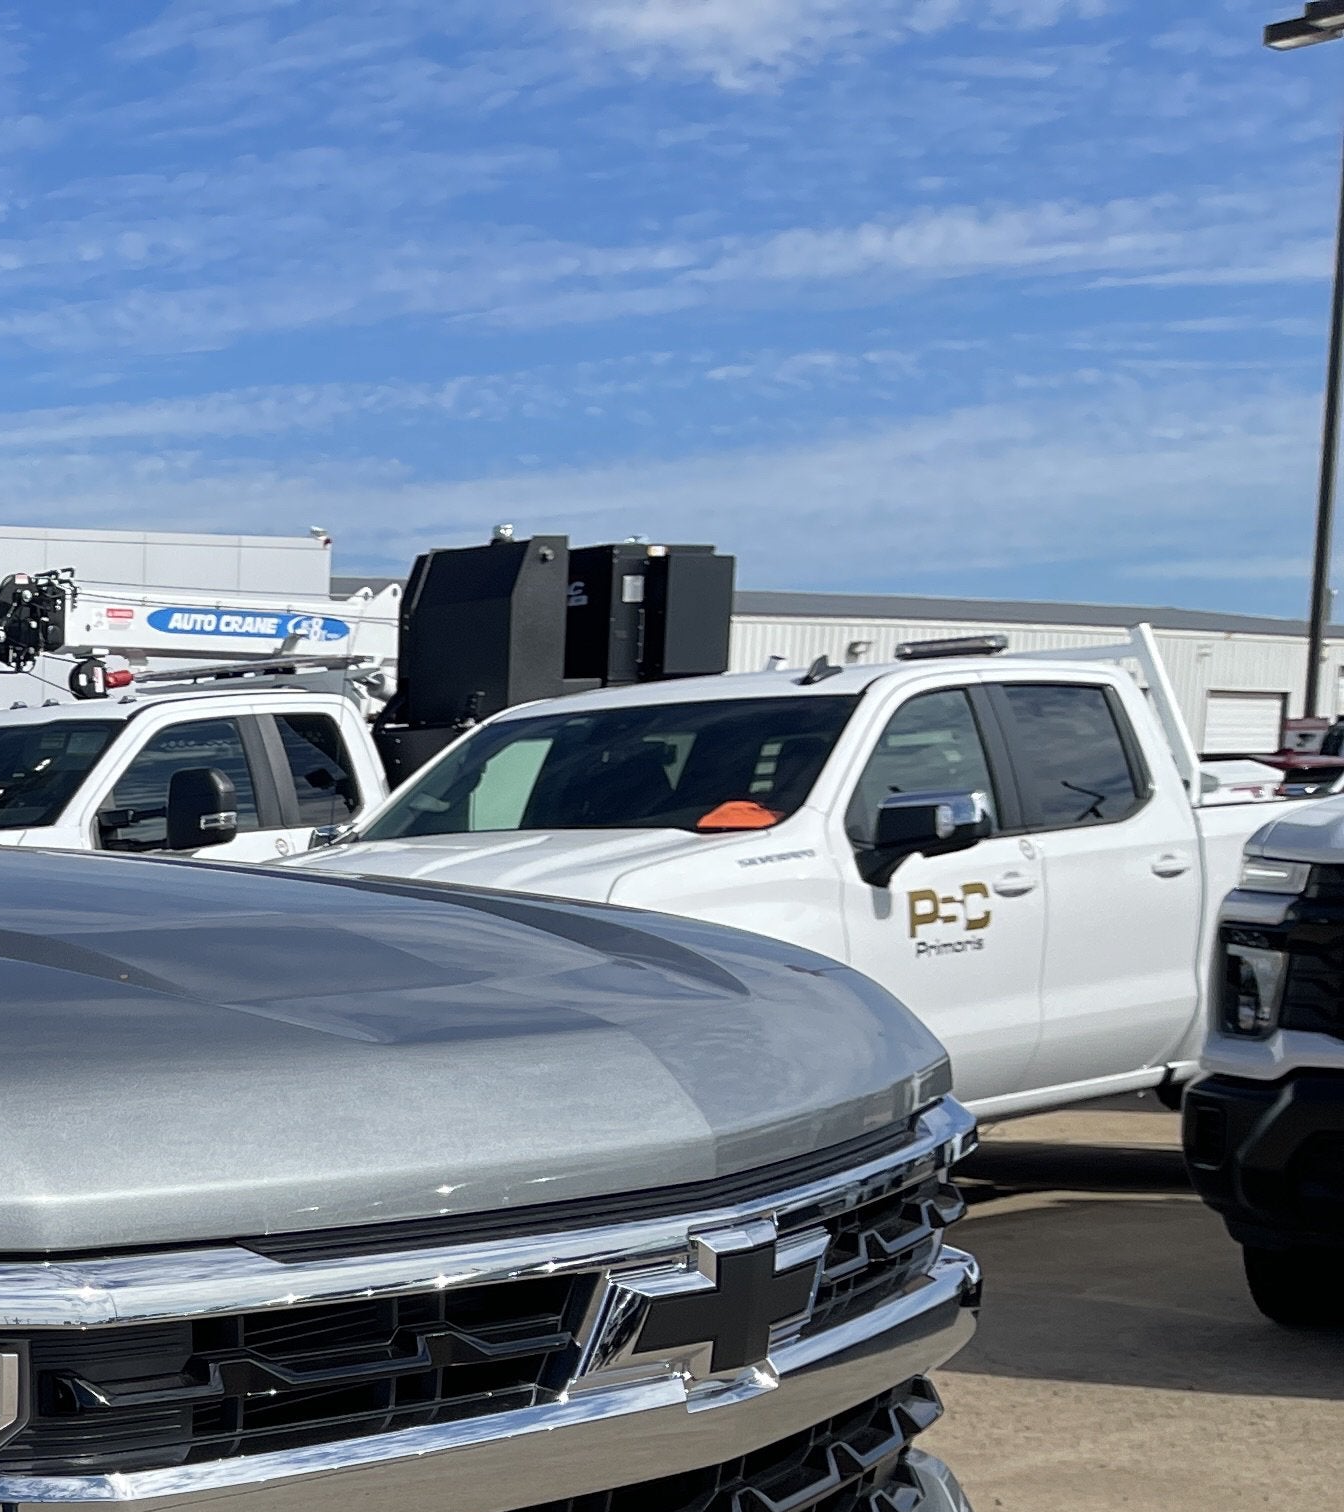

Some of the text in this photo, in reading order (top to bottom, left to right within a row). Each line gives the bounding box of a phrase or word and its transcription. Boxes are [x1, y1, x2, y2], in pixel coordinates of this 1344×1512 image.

[168, 613, 217, 632] AUTO
[219, 615, 279, 635] CRANE
[915, 935, 984, 958] Primoris
